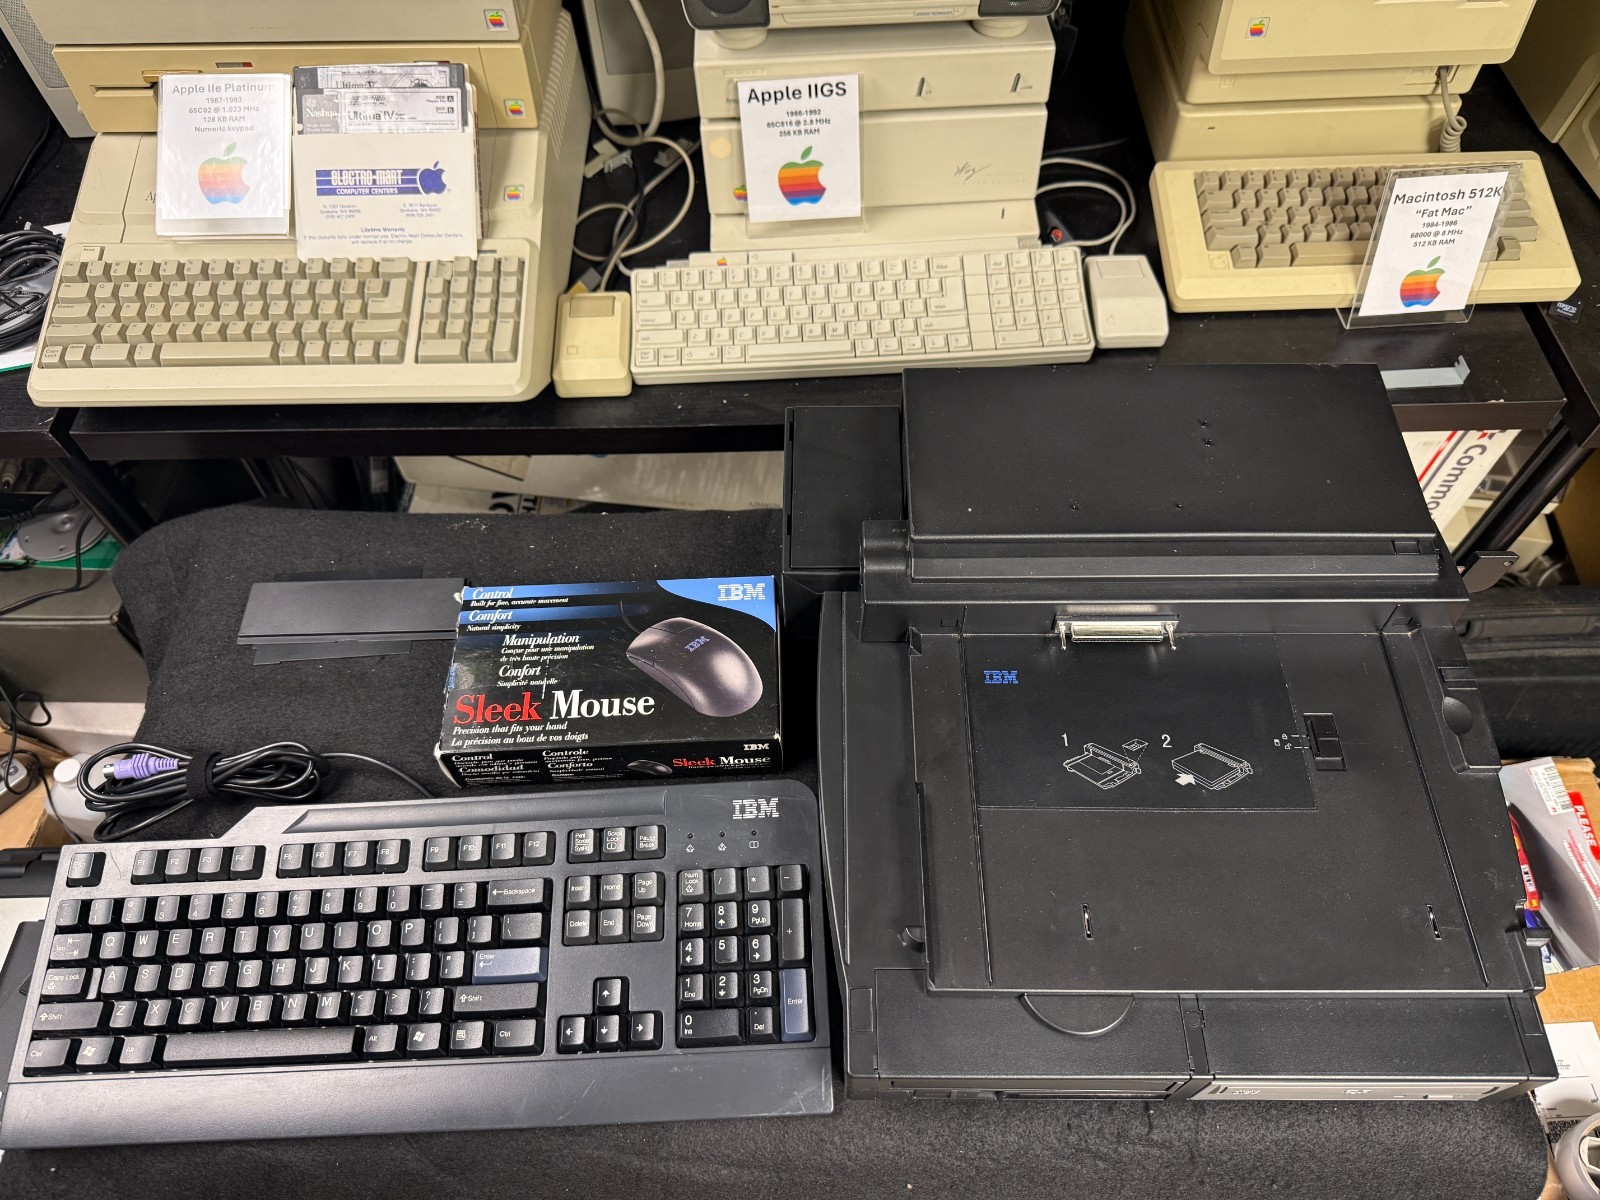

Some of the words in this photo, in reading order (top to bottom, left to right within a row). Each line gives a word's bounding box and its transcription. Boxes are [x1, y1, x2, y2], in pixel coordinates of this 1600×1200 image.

[172, 84, 205, 95] Apple
[208, 84, 222, 93] IIe
[747, 85, 802, 106] Apple
[808, 81, 847, 99] IIGS
[786, 109, 821, 118] 1986-1992
[228, 125, 254, 134] keypad
[1393, 188, 1466, 204] Macintosh
[1468, 186, 1504, 199] 512K
[1422, 220, 1458, 228] 1984-1986
[1426, 444, 1488, 514] Commo
[472, 588, 514, 600] Control
[718, 582, 766, 601] IBM
[468, 609, 513, 623] Comfort
[492, 623, 522, 631] simplicity
[502, 632, 580, 648] Manipulation
[684, 636, 710, 652] IBM
[554, 644, 594, 653] manipulation
[540, 654, 568, 662] précision
[498, 664, 541, 679] Confort
[984, 670, 1018, 684] IBM
[496, 680, 528, 688] Simplicité
[454, 691, 542, 725] Sleek
[549, 689, 656, 720] Mouse
[452, 726, 490, 736] Precision
[492, 724, 508, 734] that
[509, 723, 523, 734] fits
[524, 724, 544, 736] your
[546, 722, 568, 730] hand
[450, 738, 463, 748] La
[464, 735, 502, 748] précision
[516, 733, 536, 744] bout
[536, 733, 548, 742] de
[564, 732, 589, 743] doigts
[1061, 732, 1068, 746] 1
[1161, 734, 1172, 748] 2
[542, 748, 589, 757] Controle
[452, 754, 494, 762] Control
[672, 757, 716, 767] Sleek
[719, 756, 771, 765] Mouse
[458, 764, 524, 774] Comodidad
[548, 762, 594, 770] Conforto
[732, 798, 780, 820] IBM
[1574, 804, 1597, 846] PLEASE
[686, 908, 692, 918] 7
[718, 906, 725, 916] 8
[752, 904, 758, 914] 9
[305, 928, 314, 938] U
[338, 926, 342, 936] I
[372, 924, 382, 934] O
[405, 923, 414, 933] P
[172, 934, 180, 944] E
[206, 932, 214, 942] R
[240, 930, 246, 940] T
[273, 929, 281, 939] Y
[106, 936, 116, 947] Q
[139, 935, 149, 945] W
[718, 940, 726, 950] 5
[752, 938, 759, 949] 6
[685, 942, 692, 952] 4
[243, 964, 252, 974] G
[276, 963, 286, 973] H
[310, 962, 318, 972] J
[342, 960, 351, 970] K
[377, 960, 384, 970] L
[107, 970, 116, 980] A
[142, 968, 150, 978] S
[174, 968, 184, 978] D
[208, 965, 217, 976] F
[718, 976, 726, 986] 2
[753, 974, 760, 984] 3
[220, 1000, 229, 1010] V
[253, 1000, 262, 1010] B
[287, 998, 298, 1008] N
[321, 996, 332, 1006] M
[116, 1006, 126, 1016] Z
[150, 1004, 159, 1014] X
[185, 1002, 194, 1012] C
[684, 1015, 692, 1025] 0
